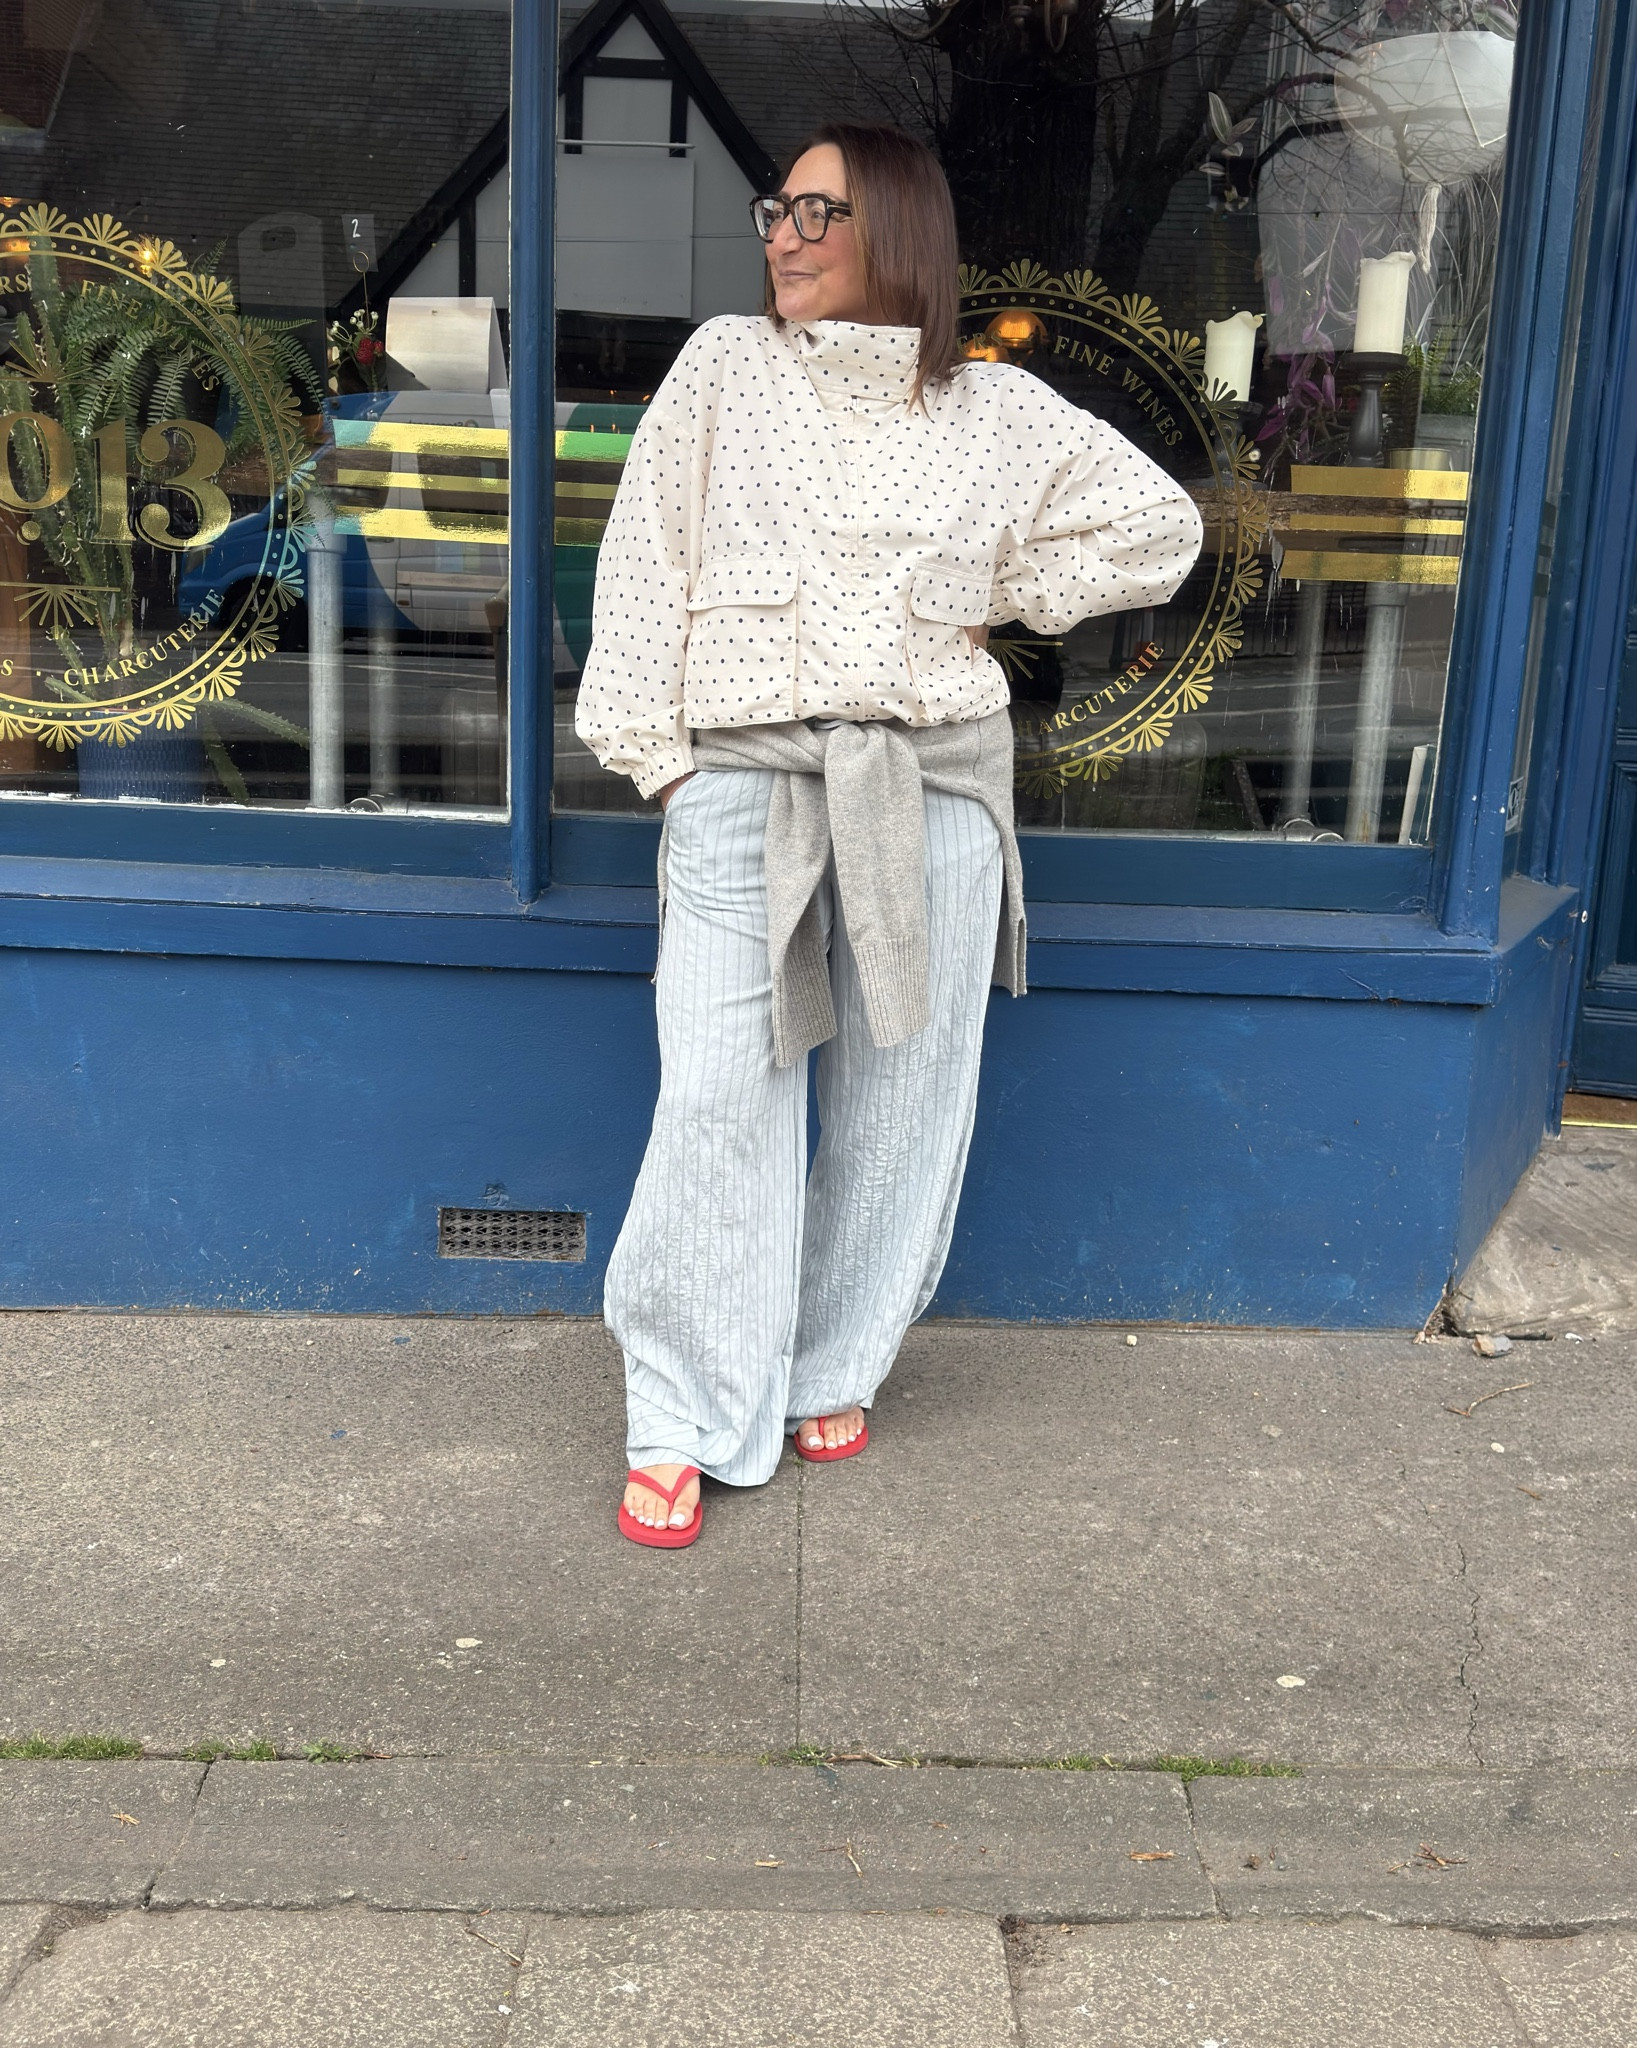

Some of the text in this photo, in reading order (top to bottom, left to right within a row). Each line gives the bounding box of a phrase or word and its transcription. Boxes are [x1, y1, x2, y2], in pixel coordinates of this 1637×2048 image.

[351, 218, 361, 238] 2
[80, 279, 143, 320] FINE
[1053, 335, 1115, 376] FINE
[1120, 367, 1183, 446] WINES
[63, 588, 225, 686] CHARCUTERIE
